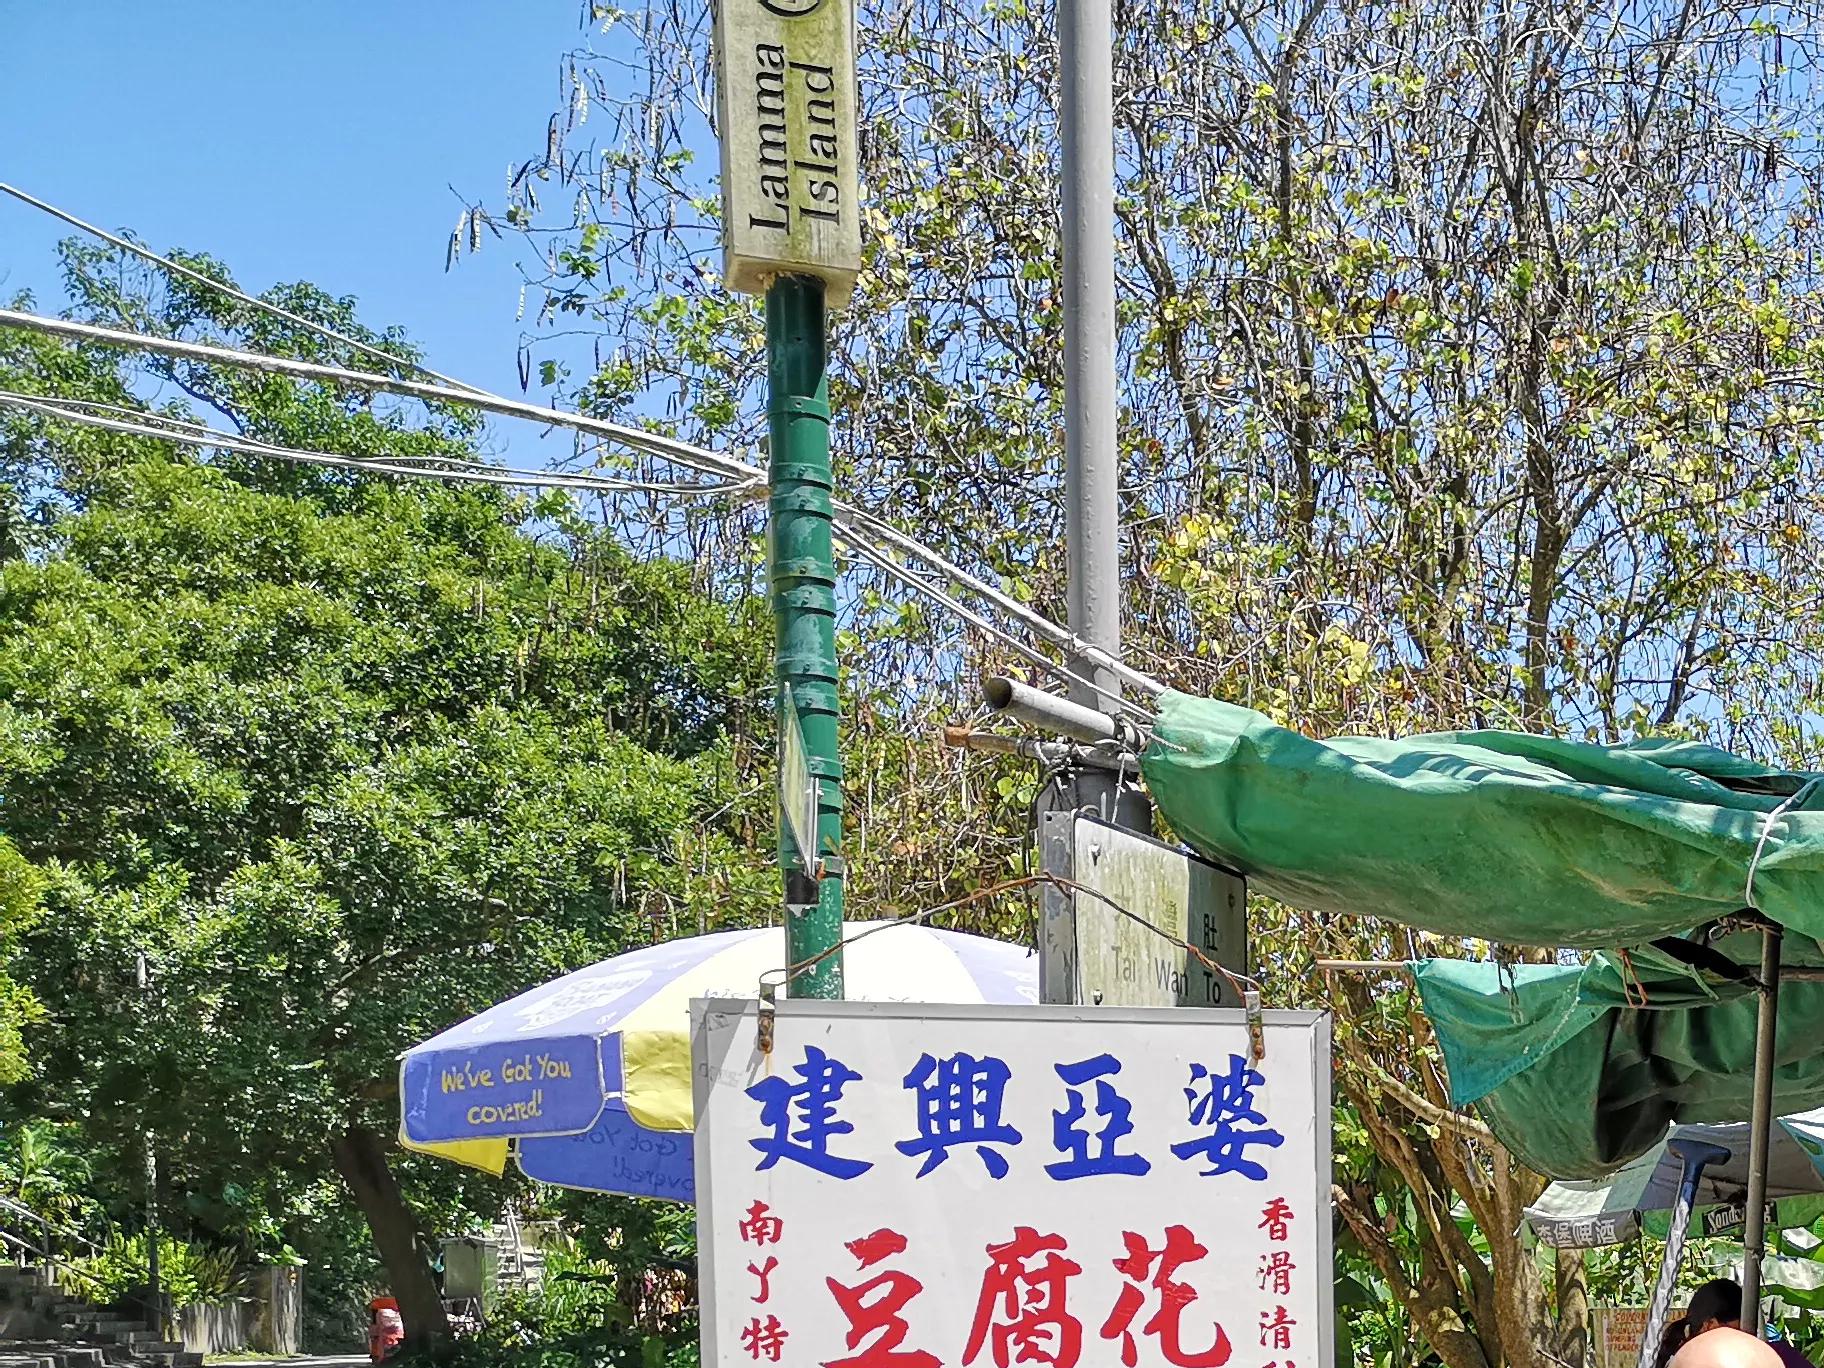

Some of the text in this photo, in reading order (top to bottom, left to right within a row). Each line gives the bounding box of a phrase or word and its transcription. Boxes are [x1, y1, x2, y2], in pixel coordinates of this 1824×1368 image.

[749, 43, 790, 236] Lamma
[788, 61, 840, 226] Island
[1111, 945, 1221, 1004] Tai Wan To
[440, 1053, 572, 1096] We've Got You
[467, 1088, 543, 1127] covered!
[744, 1045, 1284, 1181] 建興亞婆
